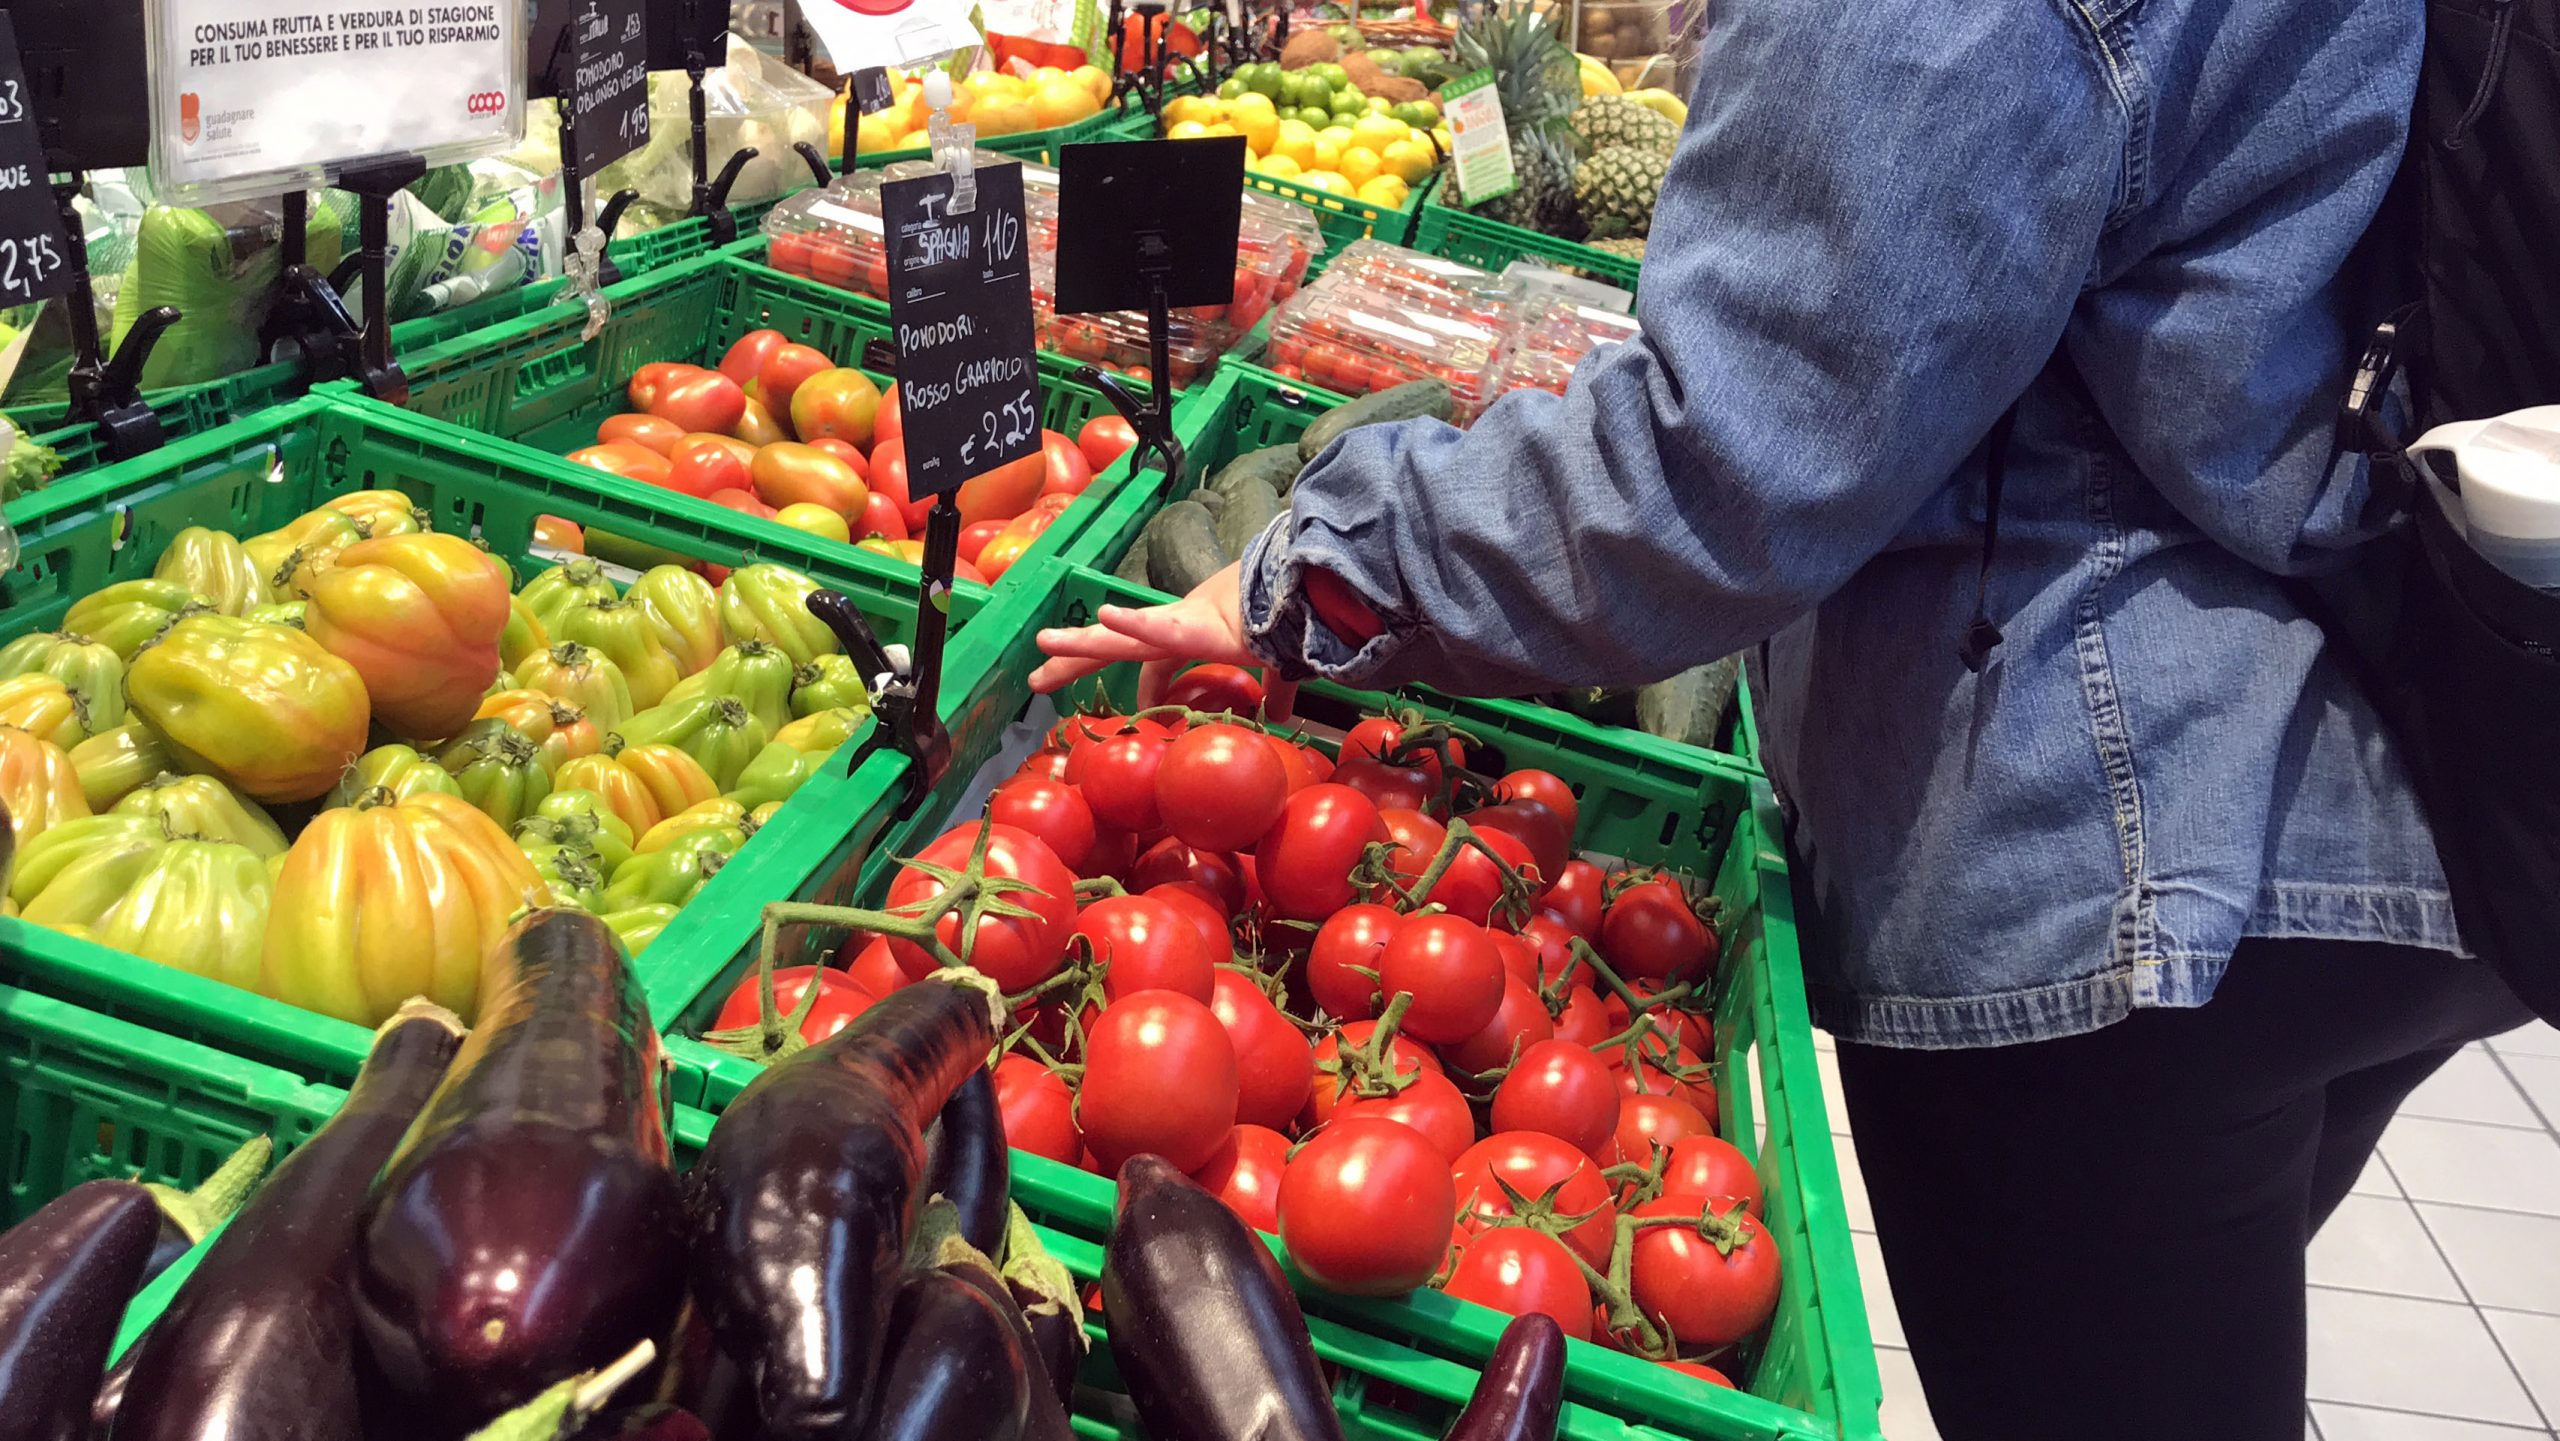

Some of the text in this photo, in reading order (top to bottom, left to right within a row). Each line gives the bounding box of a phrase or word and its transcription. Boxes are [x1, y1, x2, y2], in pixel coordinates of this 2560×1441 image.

[190, 24, 500, 67] PER IL TUO BENESSERE E PER IL TUO RISPARMIO
[195, 5, 494, 44] CONSUMA FRUTTA E VERDURA DI STAGIONE
[576, 51, 624, 92] POMODORO
[576, 60, 646, 115] OBLONGO VERDE
[205, 109, 254, 128] guadagnare
[468, 91, 505, 116] coop
[206, 126, 232, 141] salute
[619, 102, 648, 149] 1,95
[918, 223, 970, 266] SPAGNA
[982, 207, 1018, 266] 110
[900, 313, 973, 358] POMODORI
[904, 356, 1022, 412] ROSSO GRAPPOLO
[982, 389, 1035, 458] 2,25
